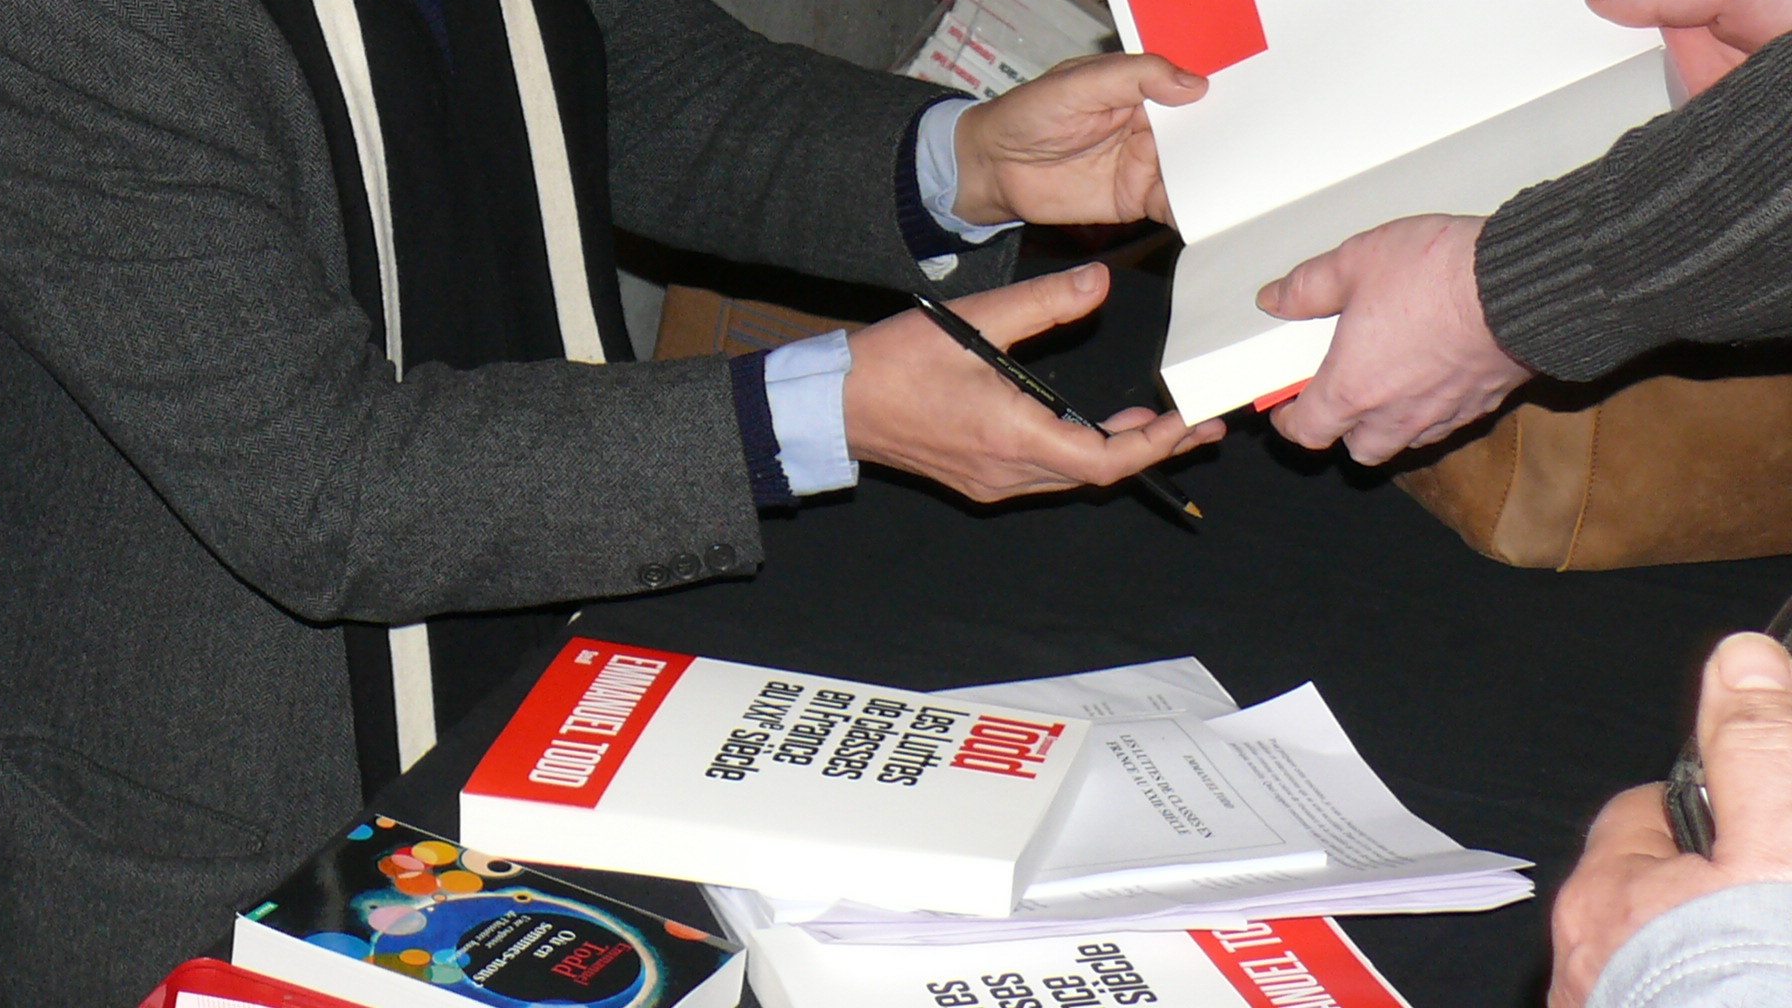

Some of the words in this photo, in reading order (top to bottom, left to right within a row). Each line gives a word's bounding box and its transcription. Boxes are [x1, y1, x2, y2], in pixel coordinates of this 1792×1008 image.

[559, 654, 667, 736] EMMANUEL
[758, 681, 805, 702] au
[809, 689, 856, 710] en
[862, 697, 914, 719] de
[772, 708, 852, 766] France
[910, 706, 970, 733] Les
[528, 739, 610, 788] TODD
[705, 728, 774, 781] siècle
[822, 717, 899, 780] classes
[949, 715, 1066, 779] Todd
[1106, 740, 1139, 774] FRANCE
[1133, 775, 1150, 786] AU
[1119, 734, 1138, 750] LES
[1132, 748, 1164, 781] LUTTES
[1157, 781, 1175, 795] DE
[1168, 794, 1203, 828] CLASSES
[533, 944, 554, 959] en
[551, 930, 577, 947] Où
[551, 941, 610, 979] Todd
[574, 942, 634, 986] Emmanuel
[1075, 943, 1158, 1004] siècle
